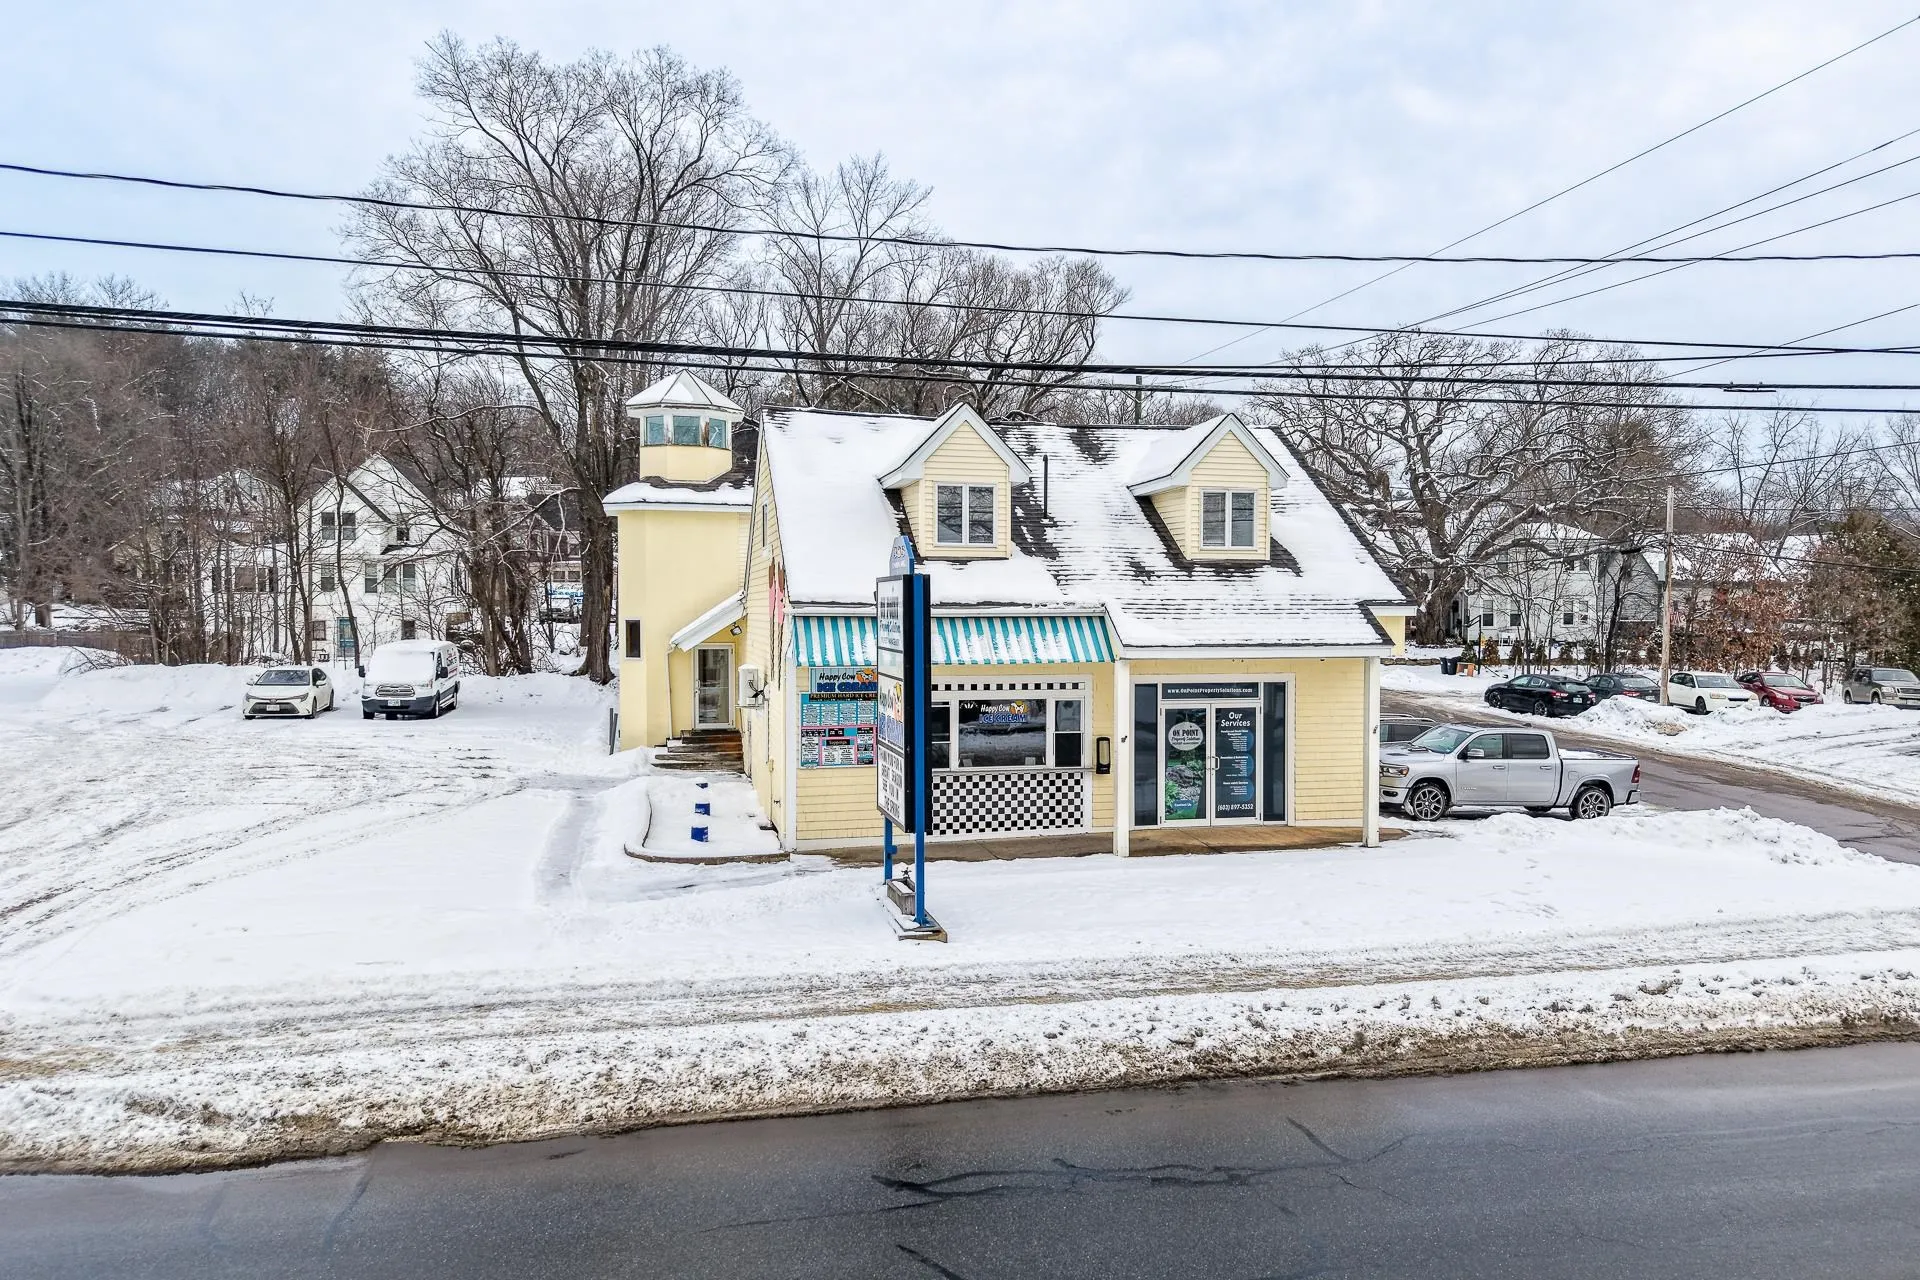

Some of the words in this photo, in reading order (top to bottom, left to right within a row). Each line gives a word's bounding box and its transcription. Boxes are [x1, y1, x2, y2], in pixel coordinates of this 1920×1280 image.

[819, 672, 841, 681] Happy
[841, 672, 856, 681] Cow
[817, 682, 836, 692] ICE
[980, 704, 998, 713] Happy
[998, 703, 1010, 712] Cow
[979, 713, 993, 723] ICE
[994, 712, 1026, 722] CREAM
[1228, 711, 1243, 719] Our
[1220, 719, 1251, 727] Services
